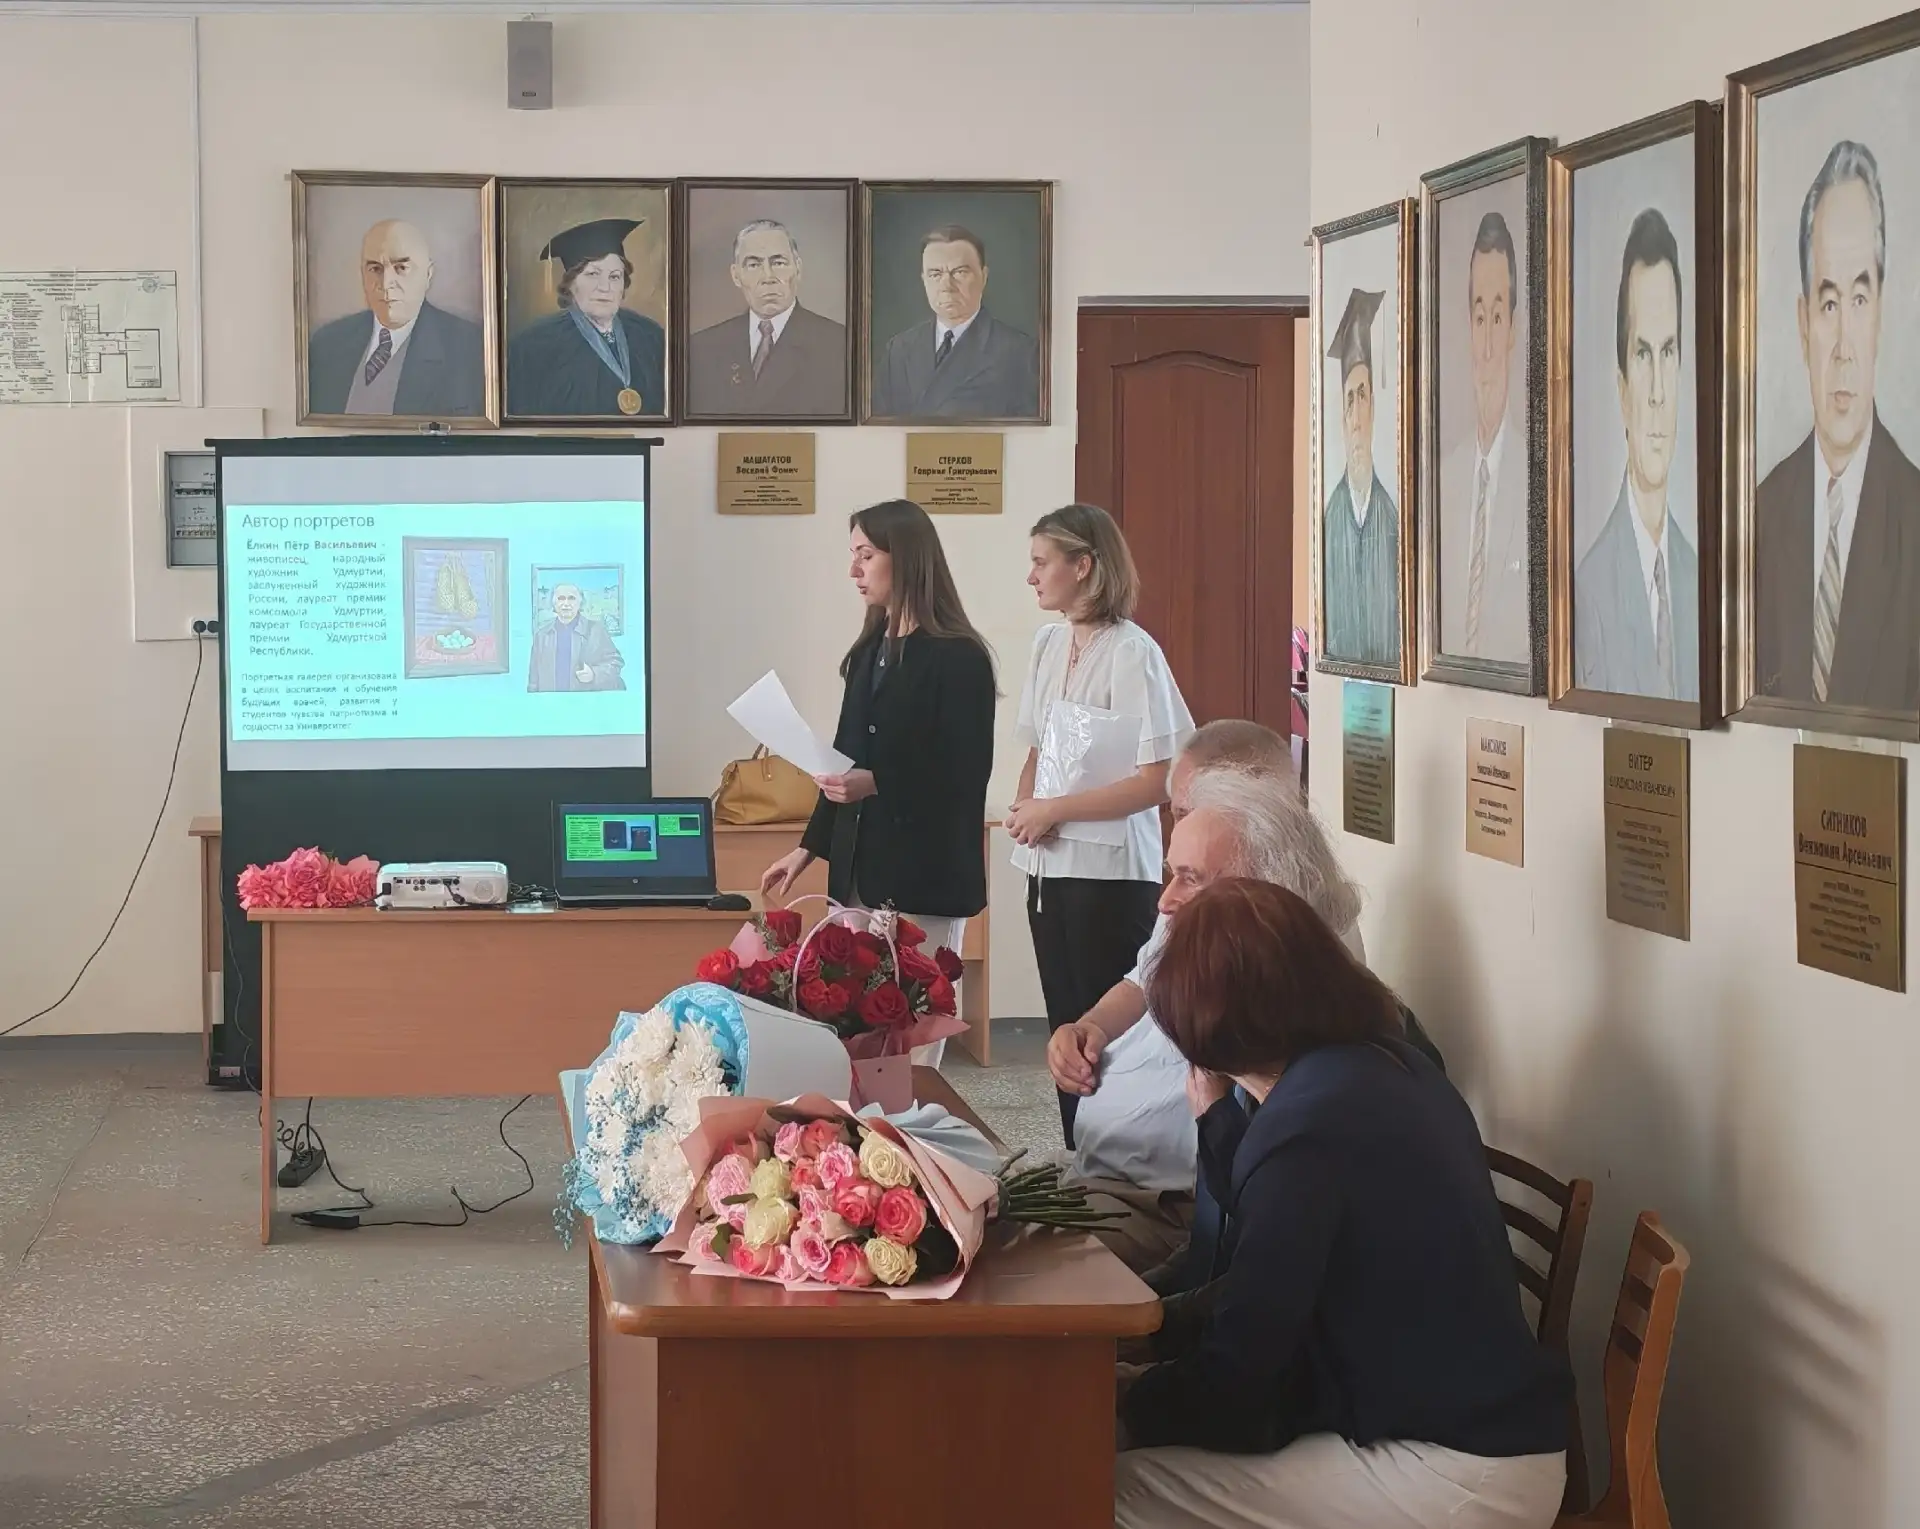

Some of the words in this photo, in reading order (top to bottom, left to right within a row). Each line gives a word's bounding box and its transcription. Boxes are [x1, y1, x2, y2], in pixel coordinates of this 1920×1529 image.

[938, 456, 972, 465] СТЕРХОВ
[242, 514, 288, 531] Автор
[294, 516, 375, 531] портретов
[246, 538, 279, 550] Ёлкин
[284, 540, 310, 551] Пётр
[314, 540, 377, 550] Васильевич
[333, 554, 386, 564] народный
[248, 568, 299, 578] художник
[333, 567, 386, 578] Удмуртии,
[248, 580, 318, 591] заслуженный
[336, 581, 387, 591] художник
[248, 594, 288, 604] России,
[297, 595, 337, 605] лауреат
[346, 595, 386, 604] премии
[249, 608, 308, 617] комсомола
[333, 606, 387, 617] Удмуртии,
[249, 621, 291, 631] лауреат
[299, 619, 387, 631] Государственной
[249, 634, 290, 643] премии
[326, 632, 387, 643] Удмуртской
[249, 646, 314, 657] Республики.
[335, 673, 397, 683] организована
[355, 684, 398, 694] обучения
[329, 710, 387, 720] патриотизма
[1628, 752, 1654, 772] ВИТЕР
[1820, 808, 1868, 839] СИТНИКОВ
[1842, 840, 1893, 873] Арсеньевич
